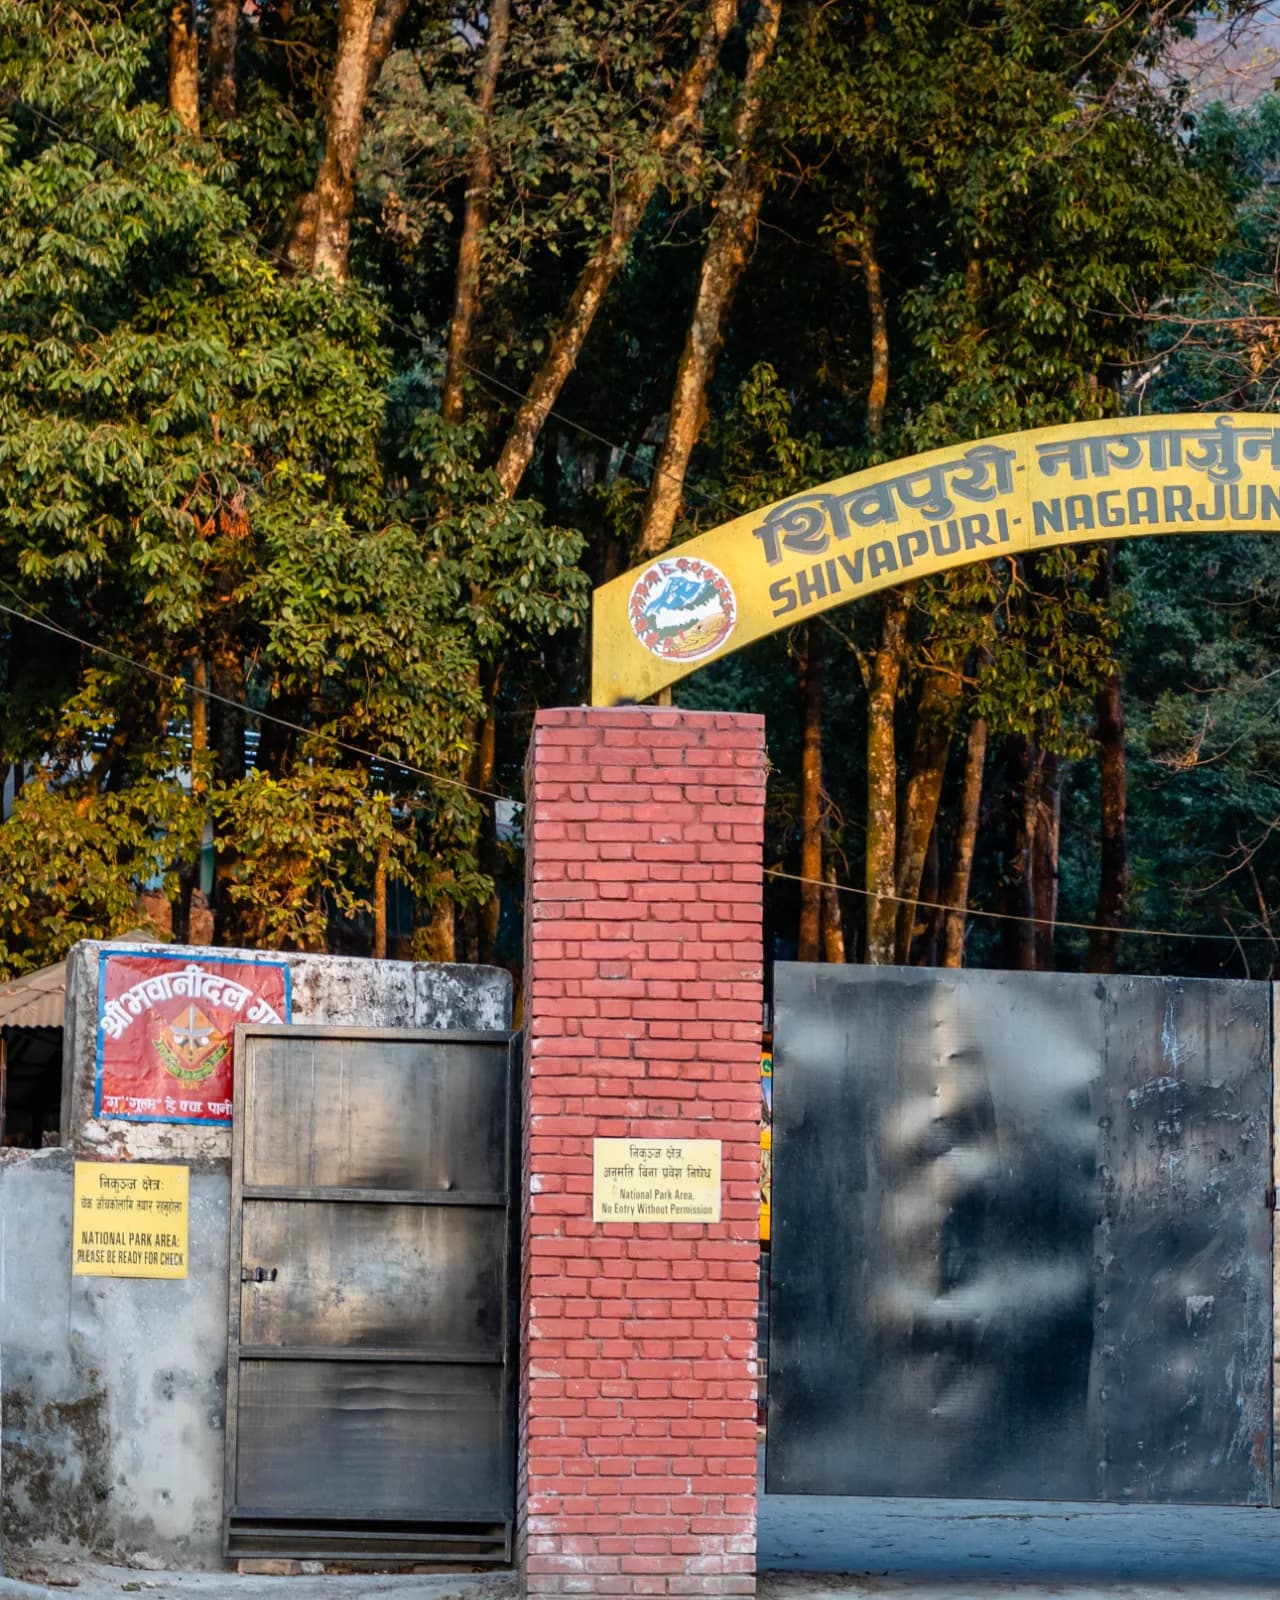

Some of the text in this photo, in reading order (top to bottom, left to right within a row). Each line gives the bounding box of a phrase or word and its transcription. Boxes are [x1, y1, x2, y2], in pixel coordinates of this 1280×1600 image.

[629, 1144, 661, 1162] निकुञ्ज
[603, 1164, 712, 1181] अनुमति बिना प्रवेश निषेध
[99, 1173, 137, 1193] निकुञ्ज
[620, 1188, 652, 1200] National
[654, 1189, 672, 1200] Park
[602, 1203, 713, 1216] No Entry Without Permission
[82, 1232, 126, 1245] NATIONAL
[129, 1233, 152, 1246] PARK
[77, 1249, 184, 1265] PLEASE BE READY FOR CHECK
